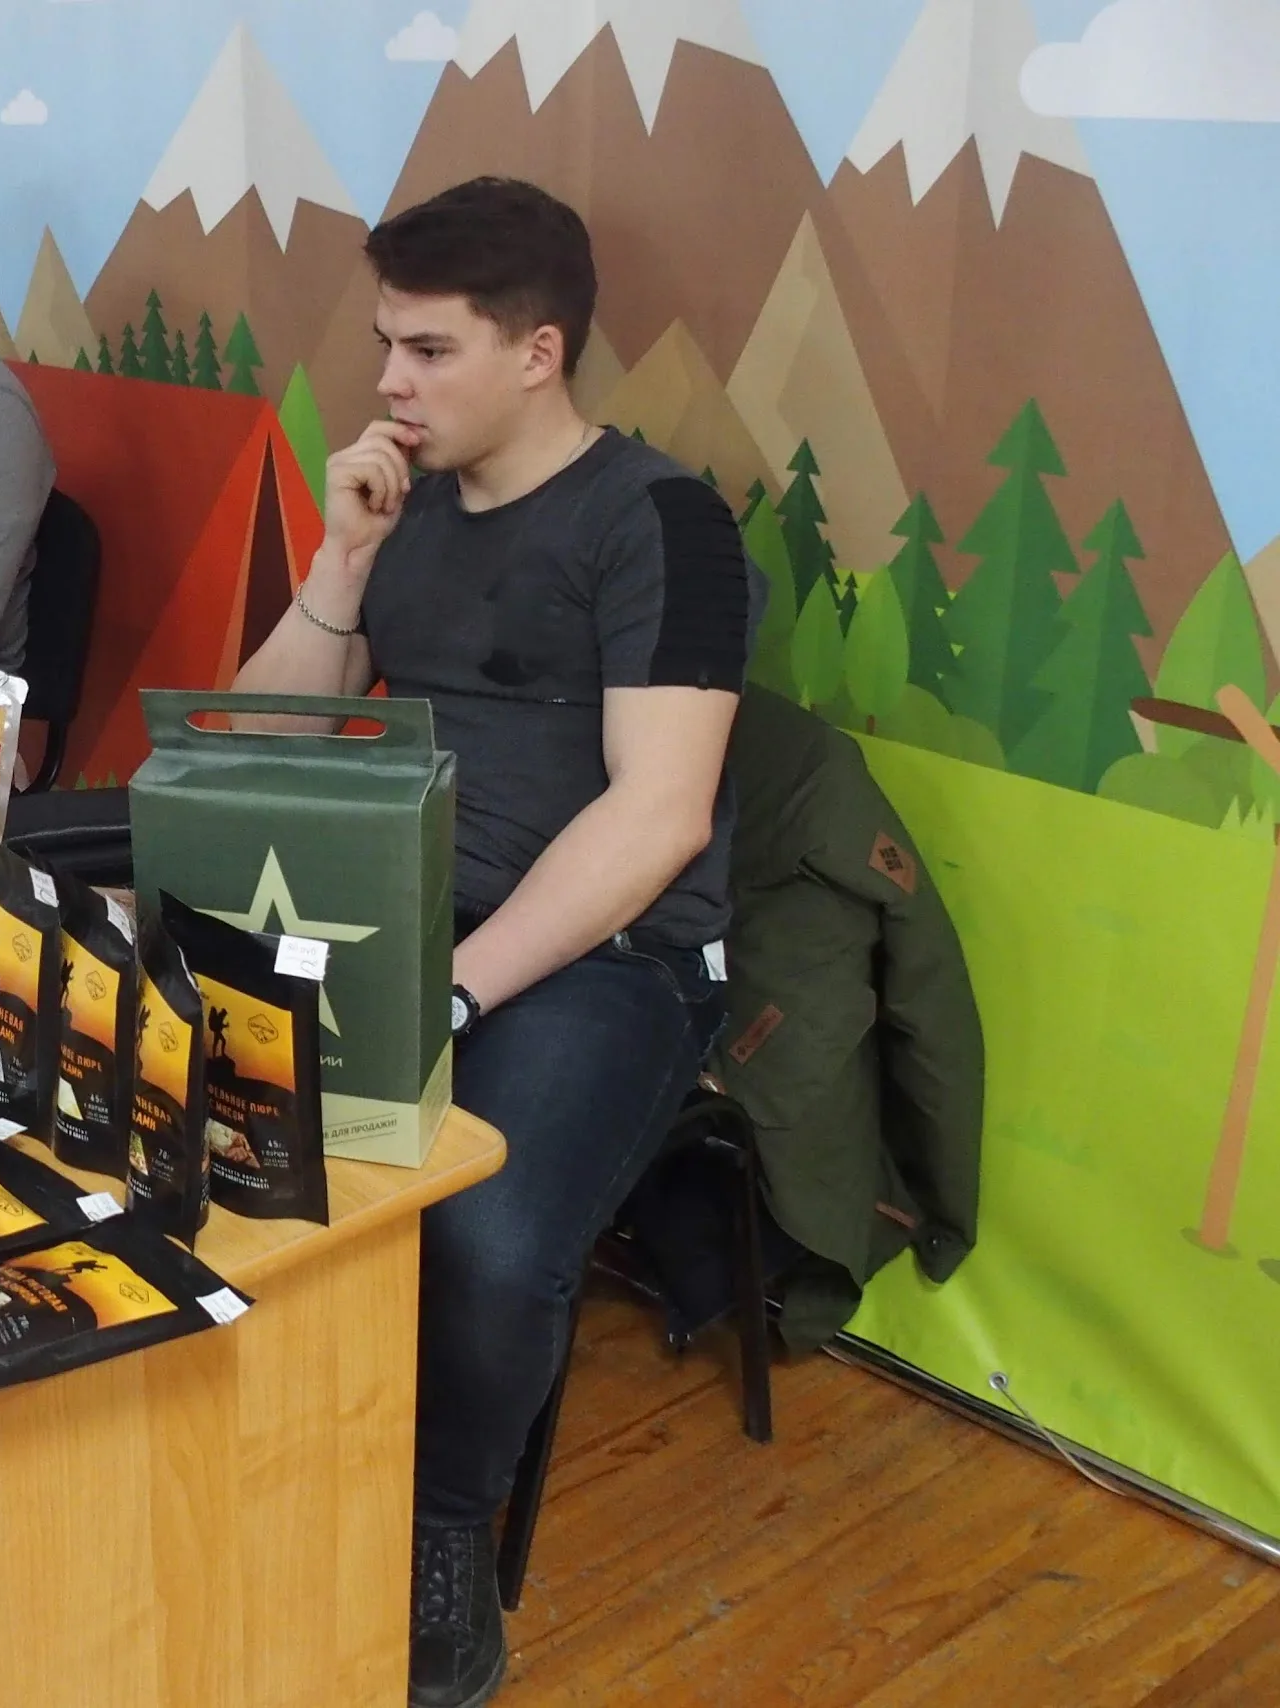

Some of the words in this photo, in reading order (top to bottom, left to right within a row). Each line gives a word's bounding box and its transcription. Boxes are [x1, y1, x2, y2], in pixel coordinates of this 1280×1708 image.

[320, 1054, 343, 1069] ИИ
[135, 1094, 173, 1126] ЧНЕВАЯ
[207, 1083, 246, 1112] ФЕЛЬНОЕ
[249, 1102, 280, 1118] ПЮРЕ
[331, 1126, 349, 1139] ДЛЯ
[351, 1118, 397, 1136] ПРОДАЖИ!
